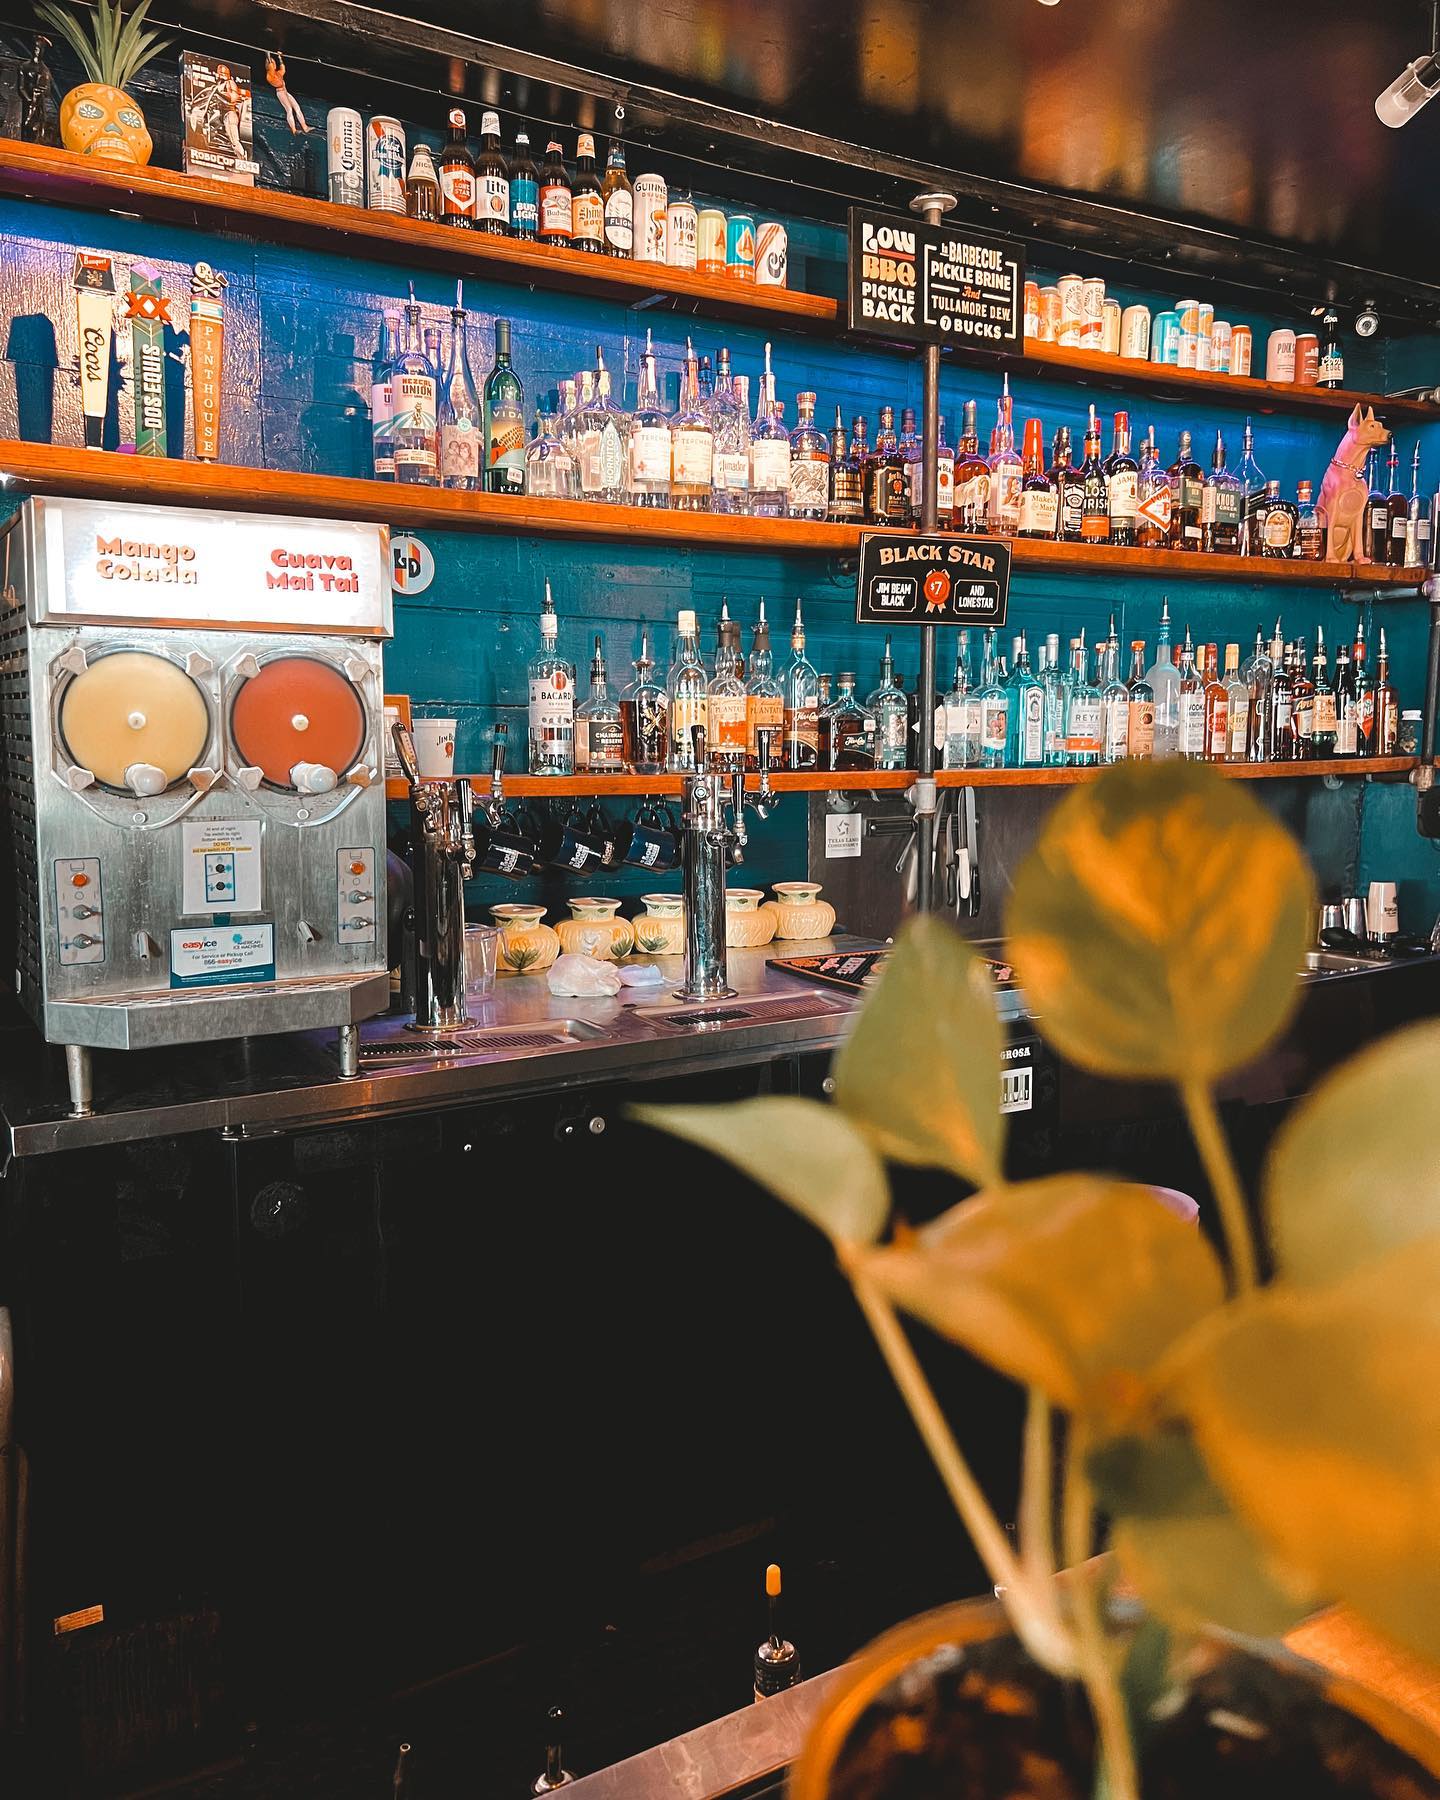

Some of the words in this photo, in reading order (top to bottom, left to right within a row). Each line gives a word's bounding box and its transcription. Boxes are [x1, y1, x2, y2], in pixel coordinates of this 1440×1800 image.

[342, 121, 356, 171] Corona
[486, 180, 505, 195] Lite
[512, 210, 539, 221] LIGHT
[516, 202, 537, 213] BUD
[863, 223, 916, 254] LOW
[83, 256, 107, 266] Banquet
[949, 241, 1003, 272] BARBECUE
[863, 255, 916, 287] BBQ
[931, 261, 974, 284] PICKLE
[975, 268, 1011, 292] BRINE
[862, 282, 916, 305] PICKLE
[863, 299, 916, 325] BACK
[931, 295, 987, 318] TULLAMORE
[954, 319, 1002, 340] BUCKS
[84, 327, 105, 383] Coors
[143, 344, 162, 391] EQUIS
[203, 326, 215, 452] PINTHOUSE
[402, 385, 432, 397] UNION
[144, 395, 163, 429] DOS
[492, 411, 523, 420] VIDA
[605, 432, 615, 483] HORNITOS
[1085, 485, 1109, 498] LOST
[96, 535, 195, 565] Mango
[270, 548, 352, 571] Guava
[879, 544, 943, 565] BLACK
[948, 545, 996, 573] STAR
[96, 559, 198, 584] Colada
[265, 571, 313, 592] Mai
[322, 573, 359, 593] Tai
[876, 582, 890, 594] JIM
[891, 584, 911, 595] BEAM
[930, 580, 943, 596] $7
[969, 585, 985, 597] AND
[881, 595, 905, 607] BLACK
[958, 597, 994, 609] LONESTAR
